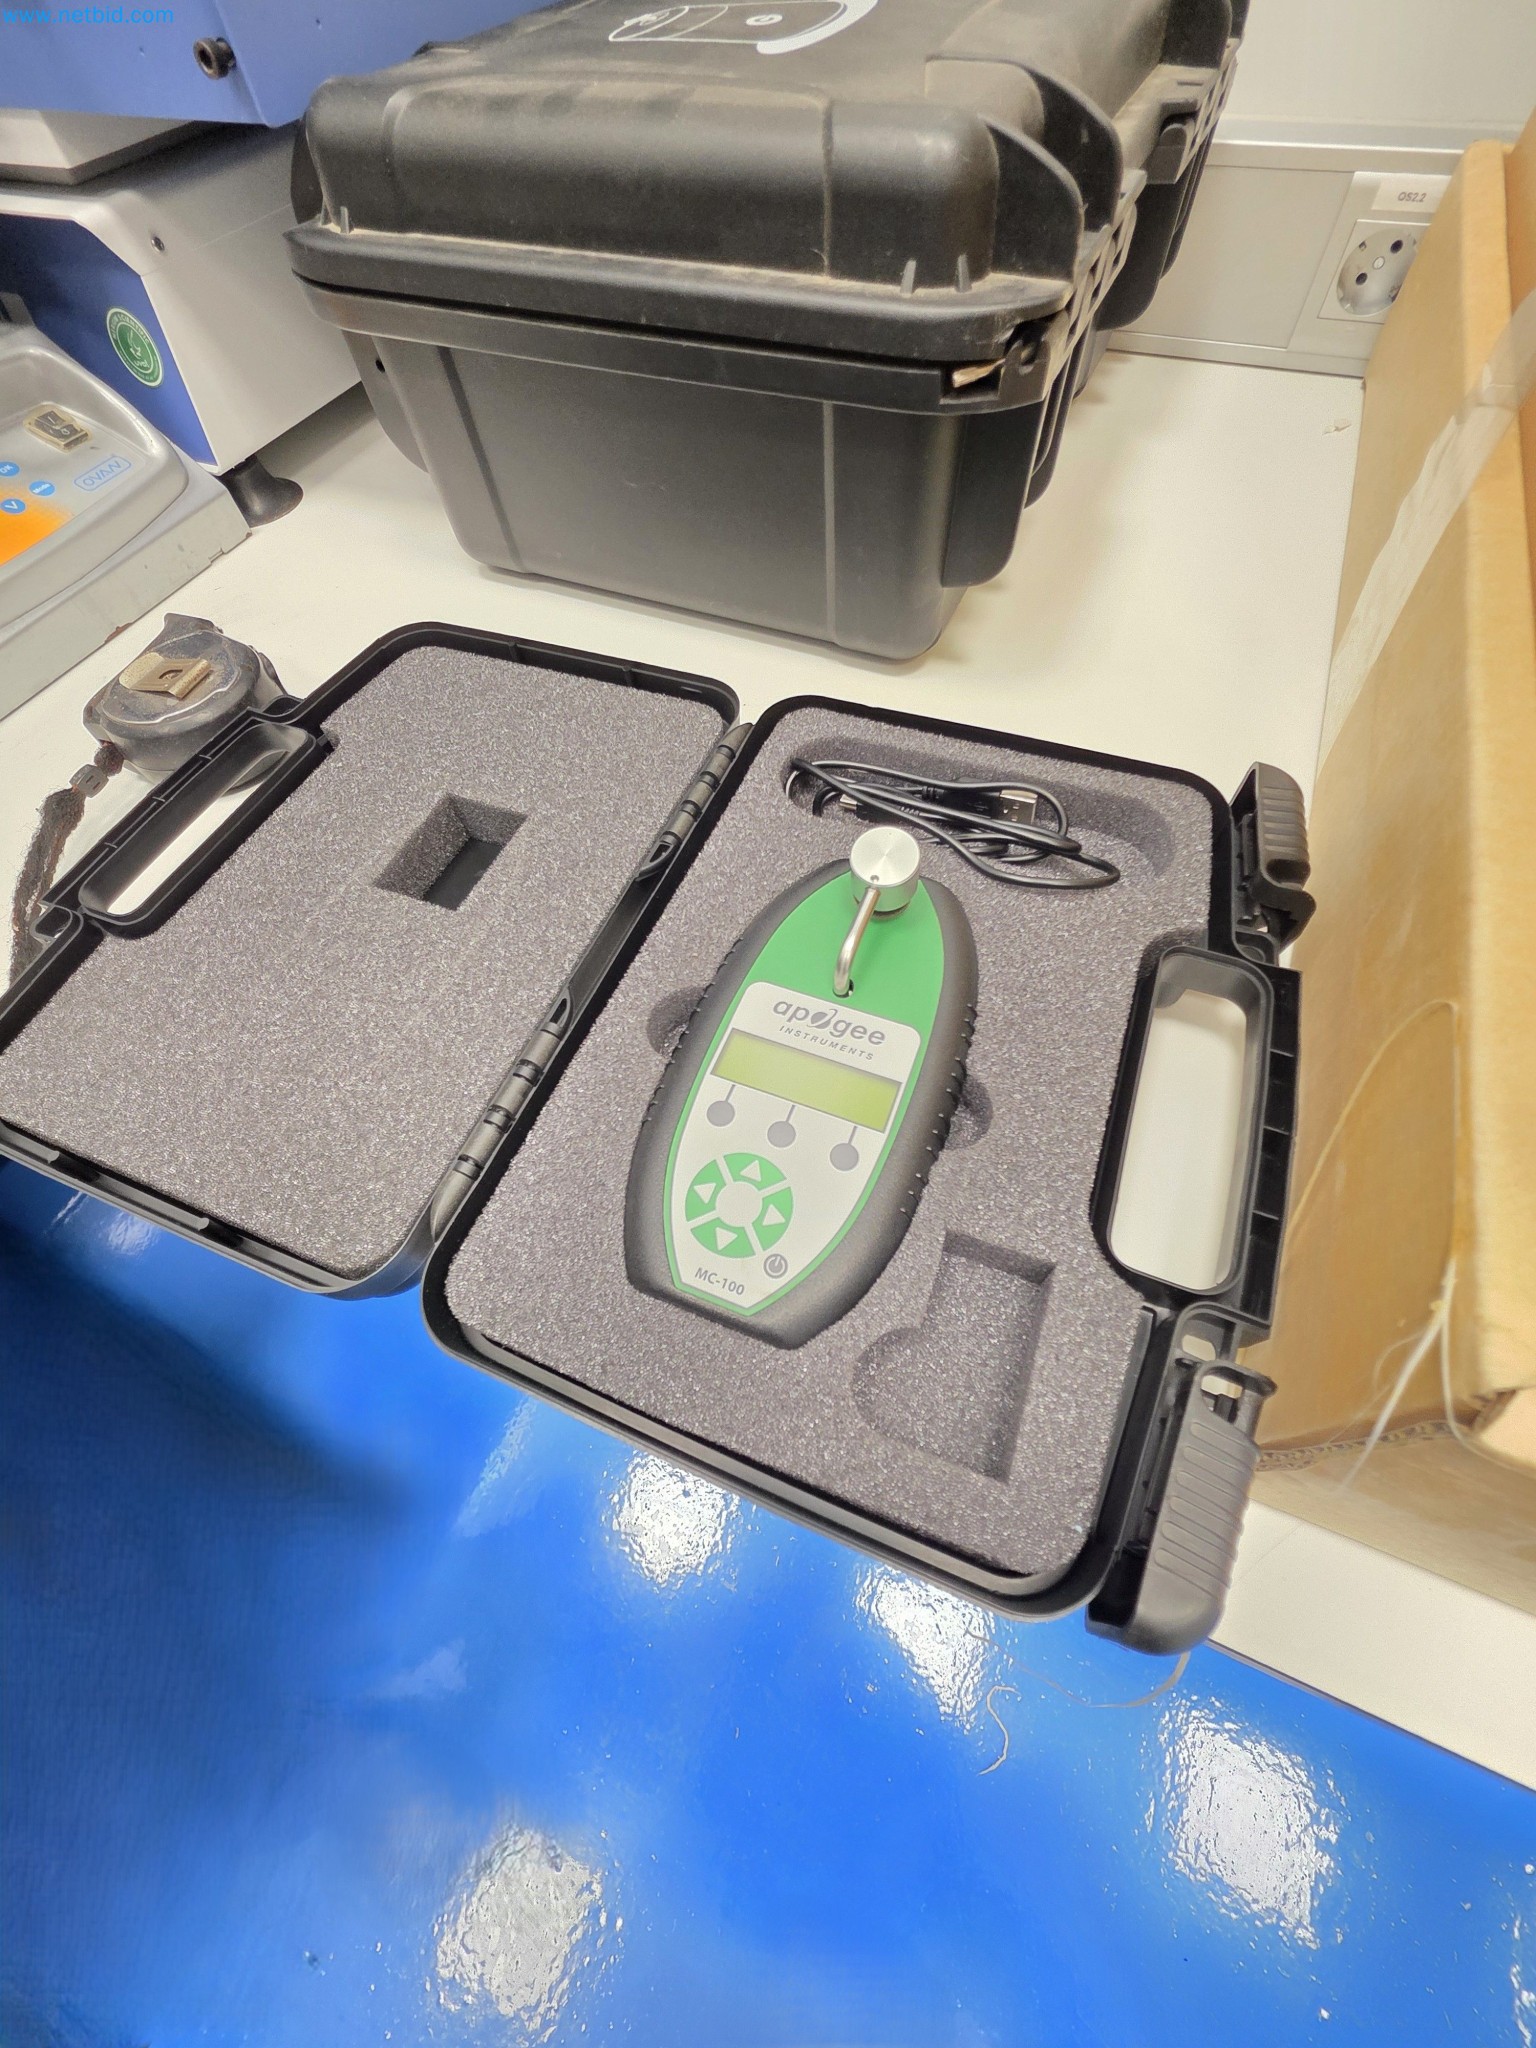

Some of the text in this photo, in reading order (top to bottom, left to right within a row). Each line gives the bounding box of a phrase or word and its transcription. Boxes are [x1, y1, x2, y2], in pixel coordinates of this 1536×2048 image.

[773, 1001, 886, 1046] apogee
[779, 1025, 874, 1061] INSTRUMENTS
[694, 1267, 745, 1296] MC-100
